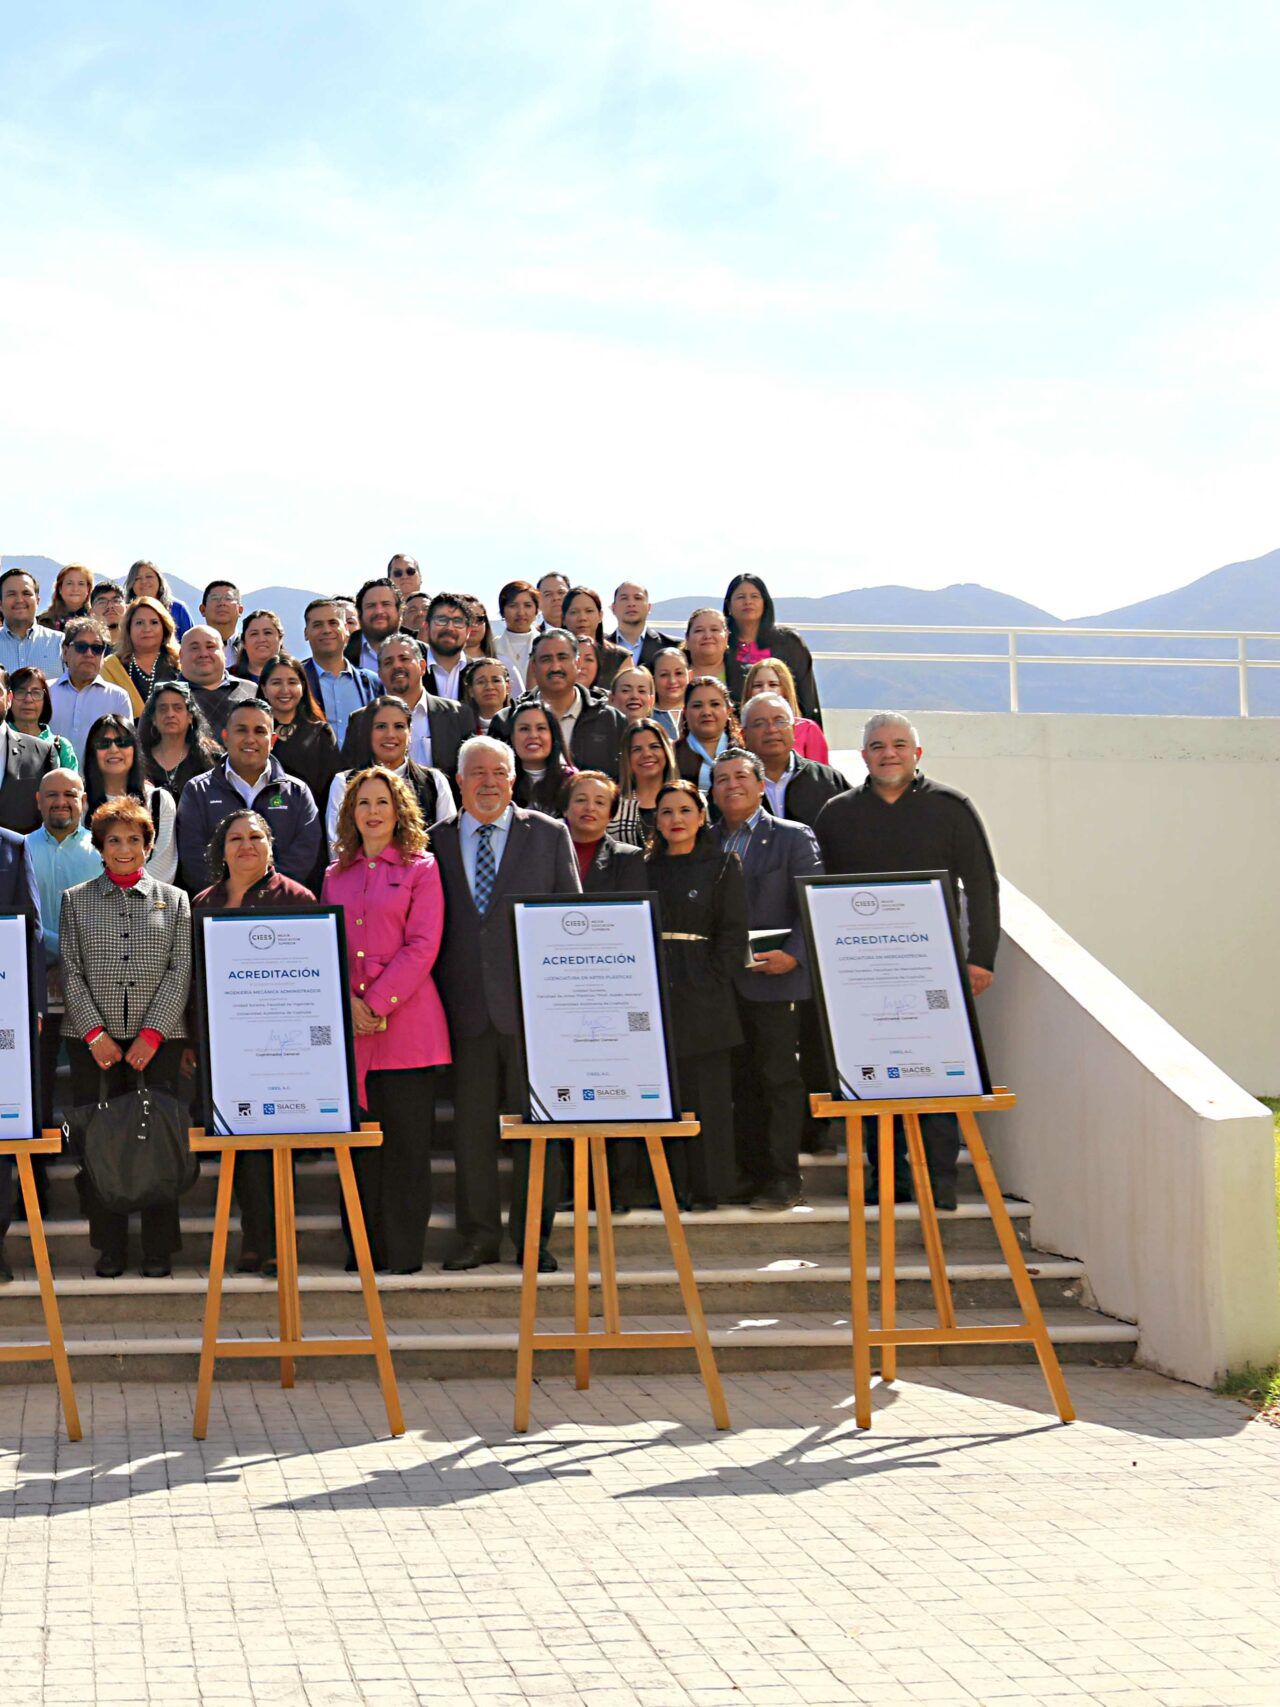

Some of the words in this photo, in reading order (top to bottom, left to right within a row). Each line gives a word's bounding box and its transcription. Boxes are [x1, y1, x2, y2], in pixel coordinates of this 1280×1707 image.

[835, 932, 929, 945] ACREDITACIÓN
[542, 953, 636, 965] ACREDITACIÓN
[228, 967, 320, 979] ACREDITACIÓN
